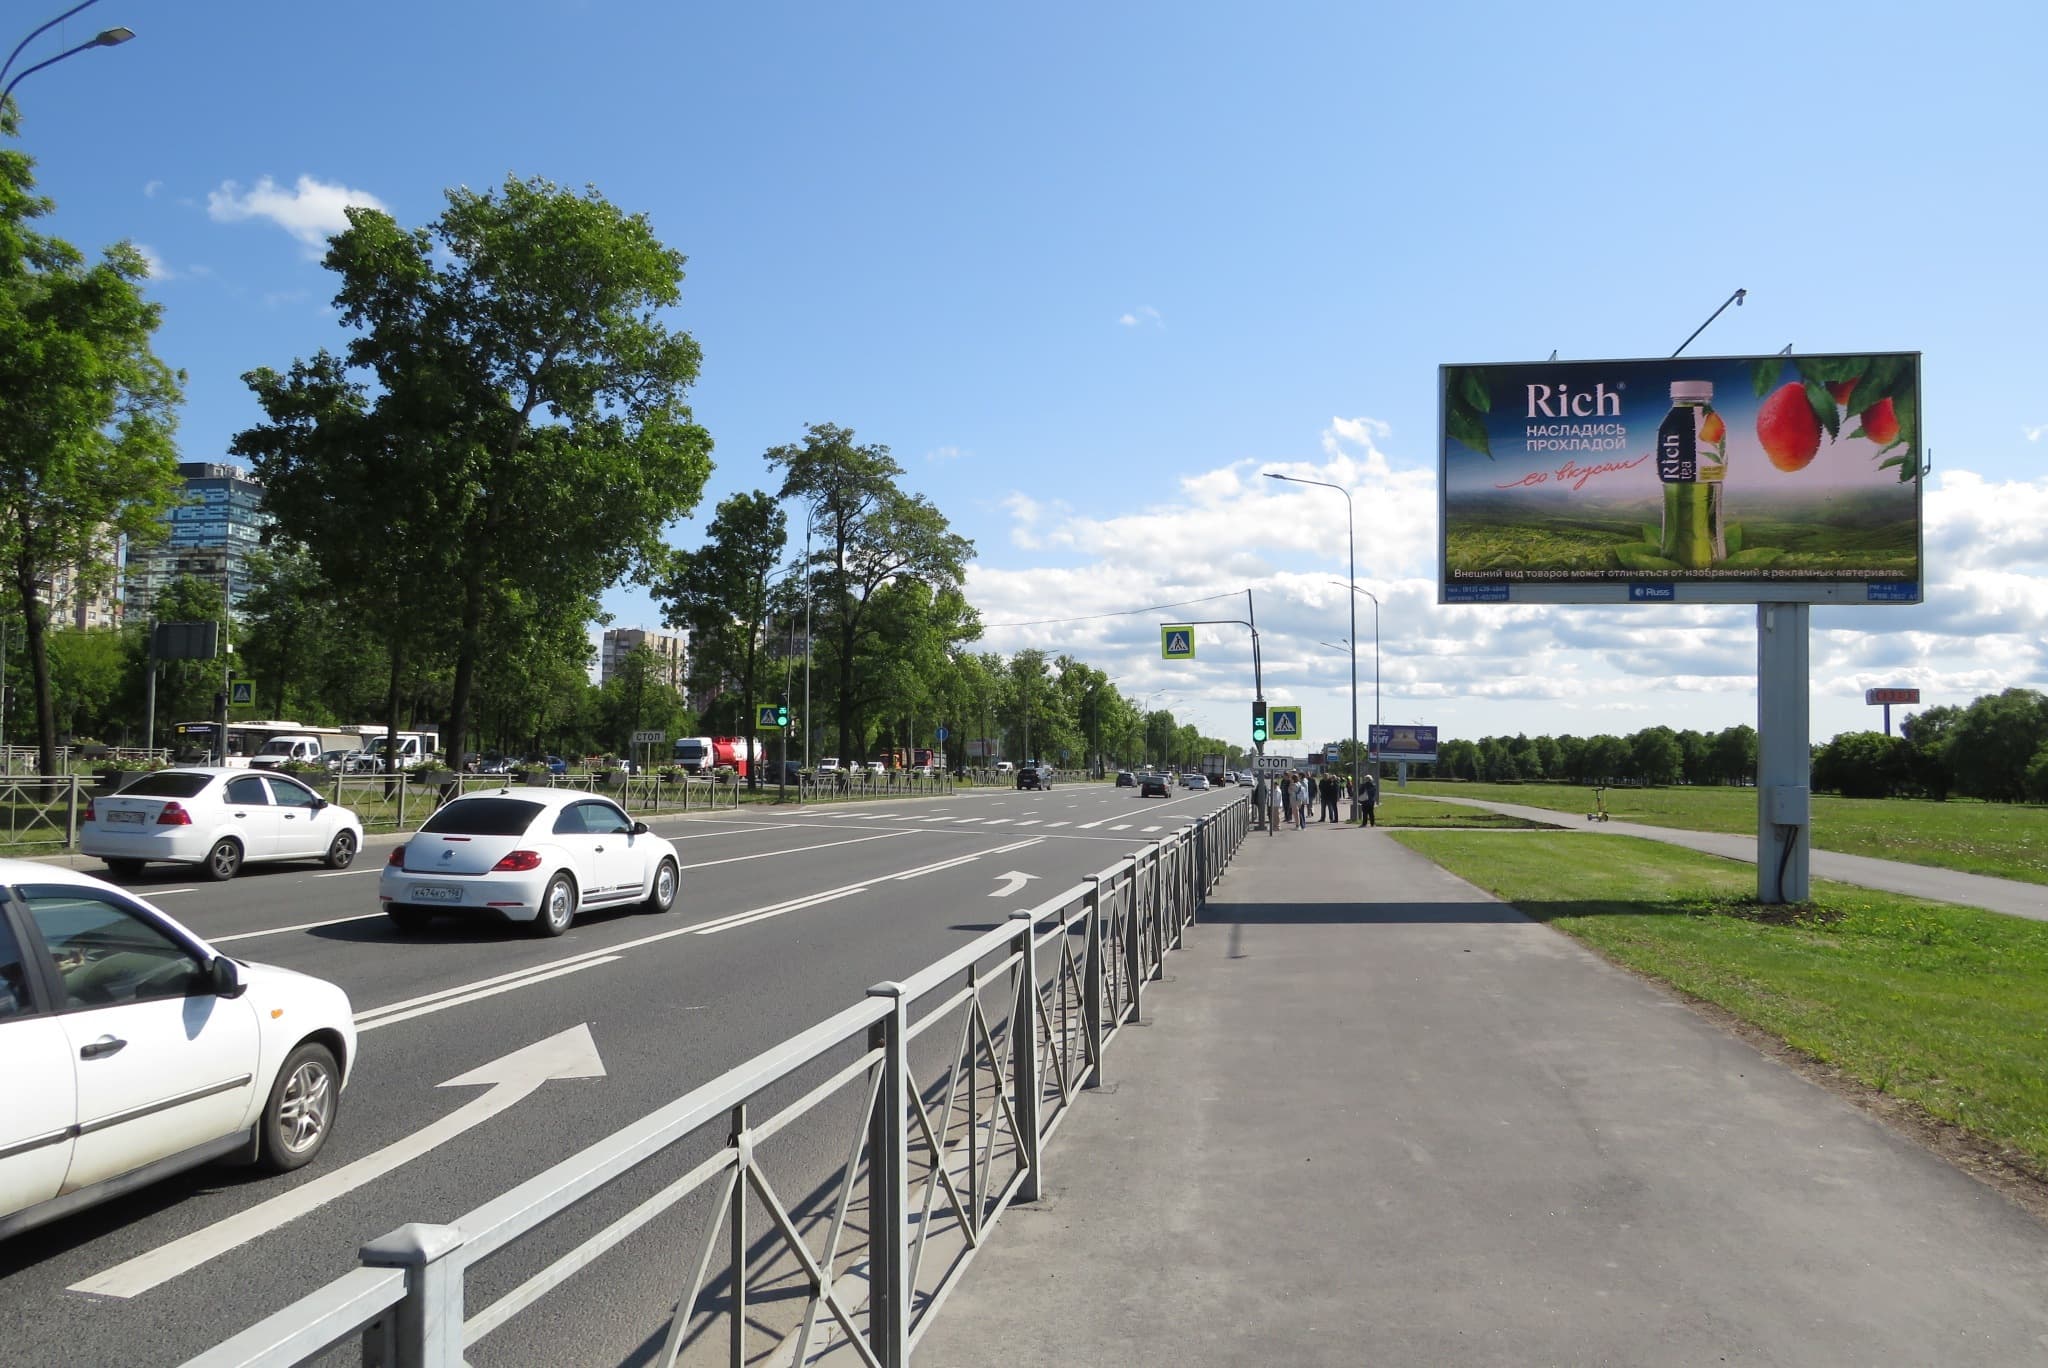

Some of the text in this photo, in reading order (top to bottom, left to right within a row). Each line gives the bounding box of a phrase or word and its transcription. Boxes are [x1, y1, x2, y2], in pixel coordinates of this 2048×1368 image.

[1527, 424, 1627, 437] НАСЛАДИСЬ
[1527, 436, 1627, 452] ПРОХЛАДОЙ
[1662, 434, 1680, 479] Rich
[1681, 461, 1693, 479] tea
[1454, 568, 1503, 578] Внешний
[1504, 569, 1524, 579] вид
[1526, 569, 1569, 579] товаров
[1571, 569, 1605, 578] может
[1607, 569, 1668, 578] отличаться
[1670, 569, 1683, 578] от
[1685, 567, 1760, 579] изображений
[1771, 569, 1834, 579] рекламных
[1646, 588, 1671, 597] Russ
[636, 732, 661, 741] СТОП
[1258, 758, 1288, 768] СТОП
